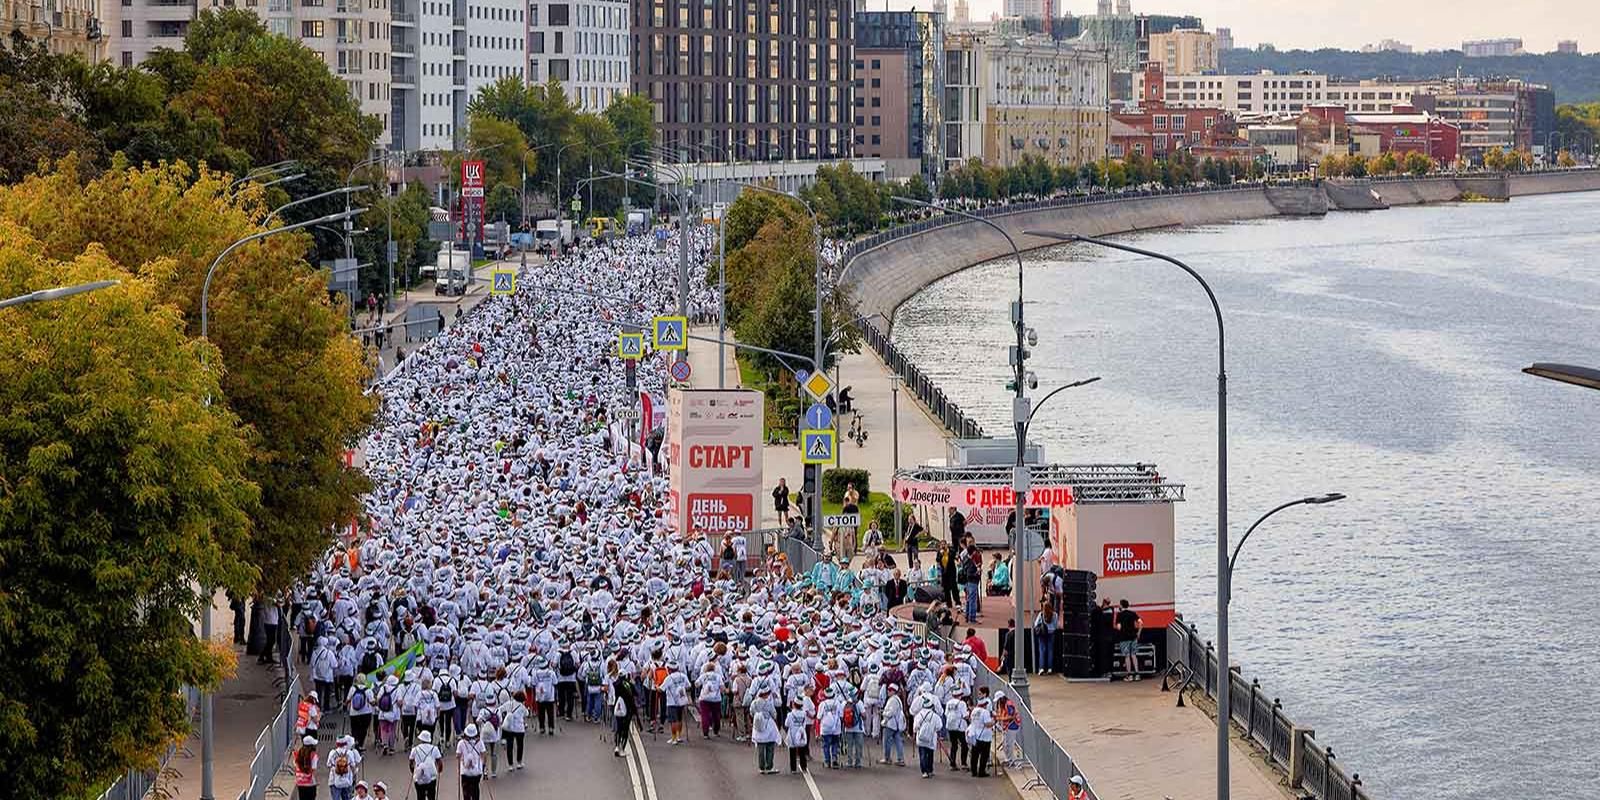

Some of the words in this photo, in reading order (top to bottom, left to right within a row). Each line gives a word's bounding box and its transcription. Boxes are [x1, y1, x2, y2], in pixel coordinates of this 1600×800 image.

[689, 445, 753, 468] СТАРТ
[910, 488, 951, 505] Доверие
[966, 488, 976, 505] С
[981, 486, 1027, 508] ДНЁ
[691, 499, 727, 515] ДЕНЬ
[691, 515, 749, 532] ХОДЬБЫ
[827, 515, 857, 526] СТОП
[1106, 547, 1134, 560] ДЕНЬ
[1107, 559, 1151, 573] ХОДЬБЫ
